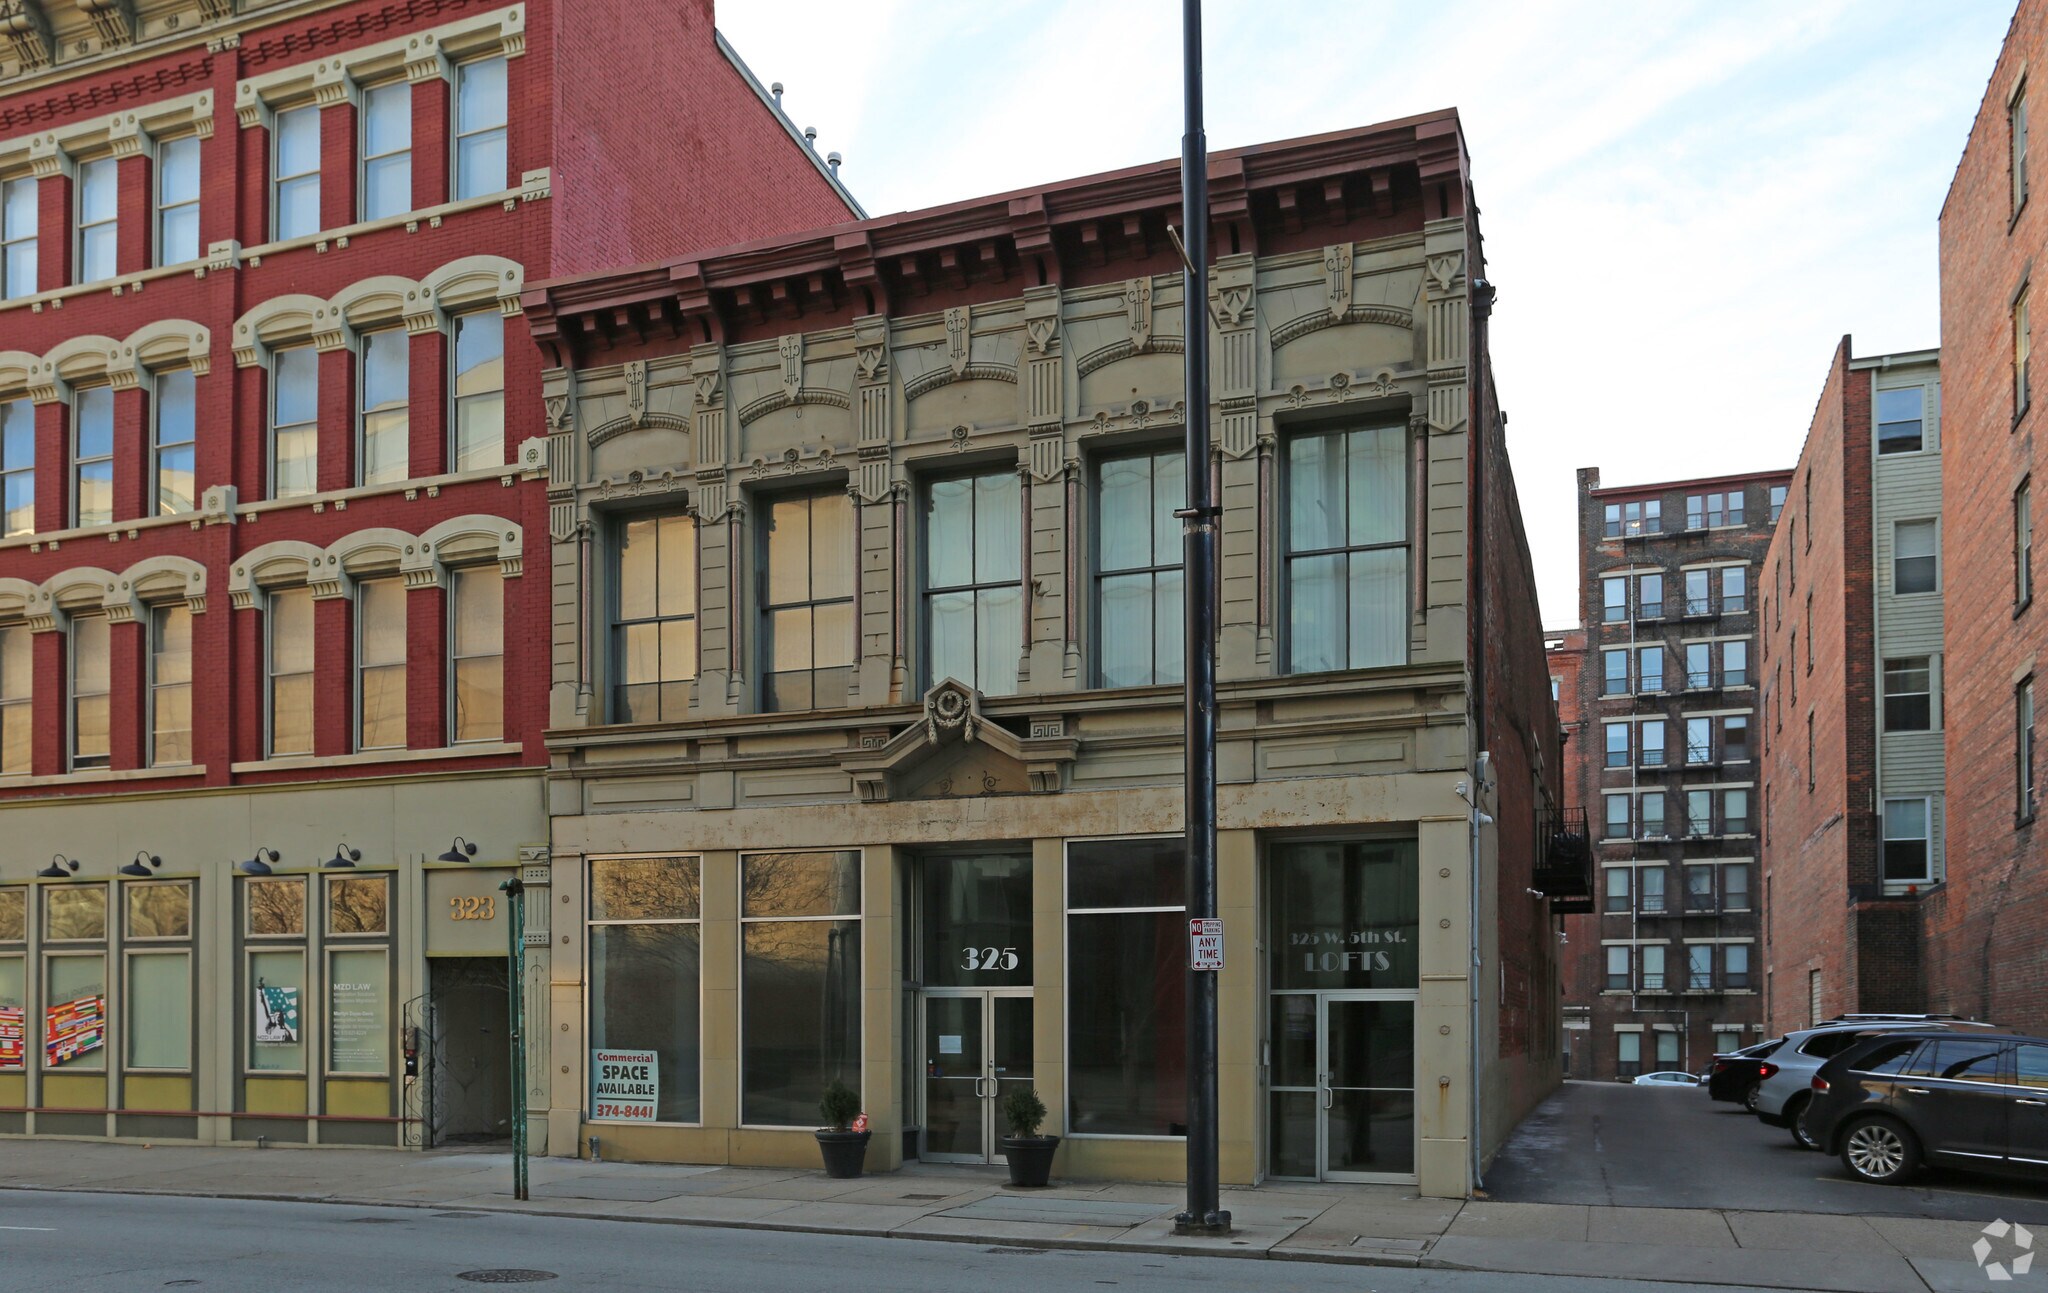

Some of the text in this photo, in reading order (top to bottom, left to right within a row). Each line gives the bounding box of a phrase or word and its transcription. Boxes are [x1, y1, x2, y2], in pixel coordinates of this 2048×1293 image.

[450, 896, 495, 921] 323
[1192, 923, 1202, 932] NO
[1199, 938, 1217, 947] ANY
[1289, 930, 1407, 945] 325 W. 5th St.
[961, 947, 1018, 970] 325
[1198, 949, 1218, 959] TIME
[1304, 950, 1390, 972] LOFTS
[597, 1052, 654, 1063] Commercial
[602, 1065, 649, 1080] SPACE
[596, 1083, 655, 1095] AVAILABLE
[597, 1104, 653, 1118] 374-8441
